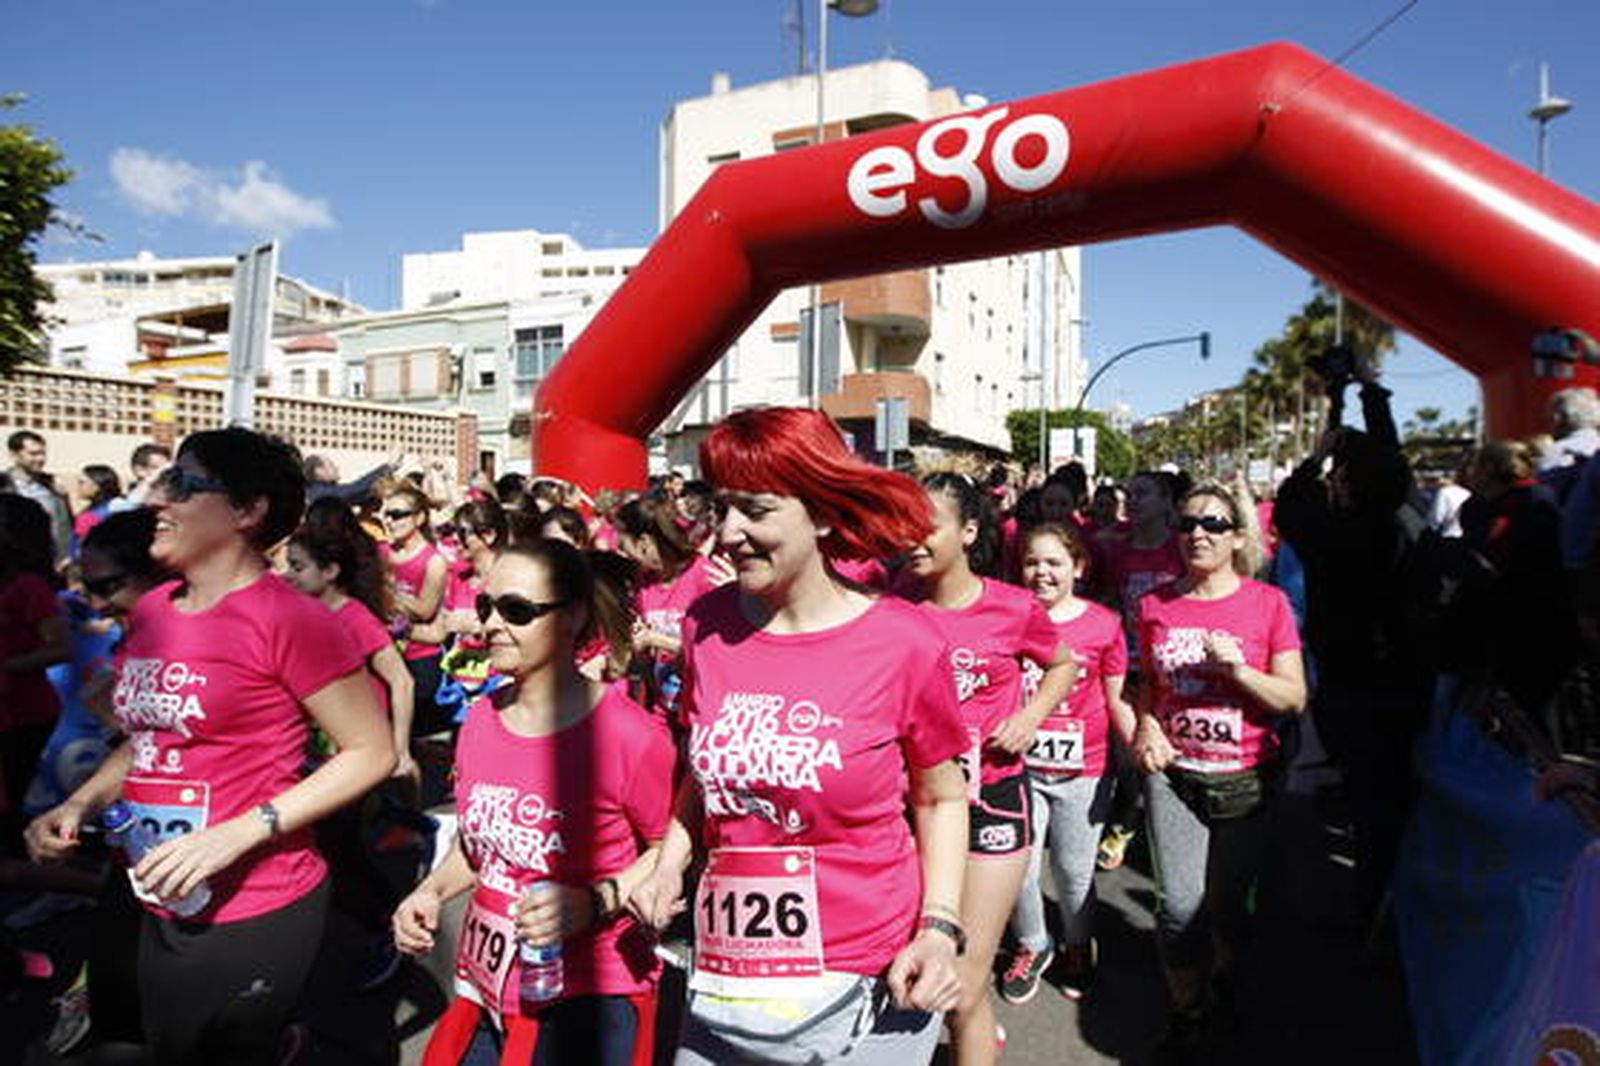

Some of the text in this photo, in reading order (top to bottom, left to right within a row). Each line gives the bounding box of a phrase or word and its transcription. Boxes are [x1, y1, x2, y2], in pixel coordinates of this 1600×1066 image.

[848, 106, 1070, 229] ego
[708, 731, 843, 771] CARRERA
[702, 890, 809, 938] 1126
